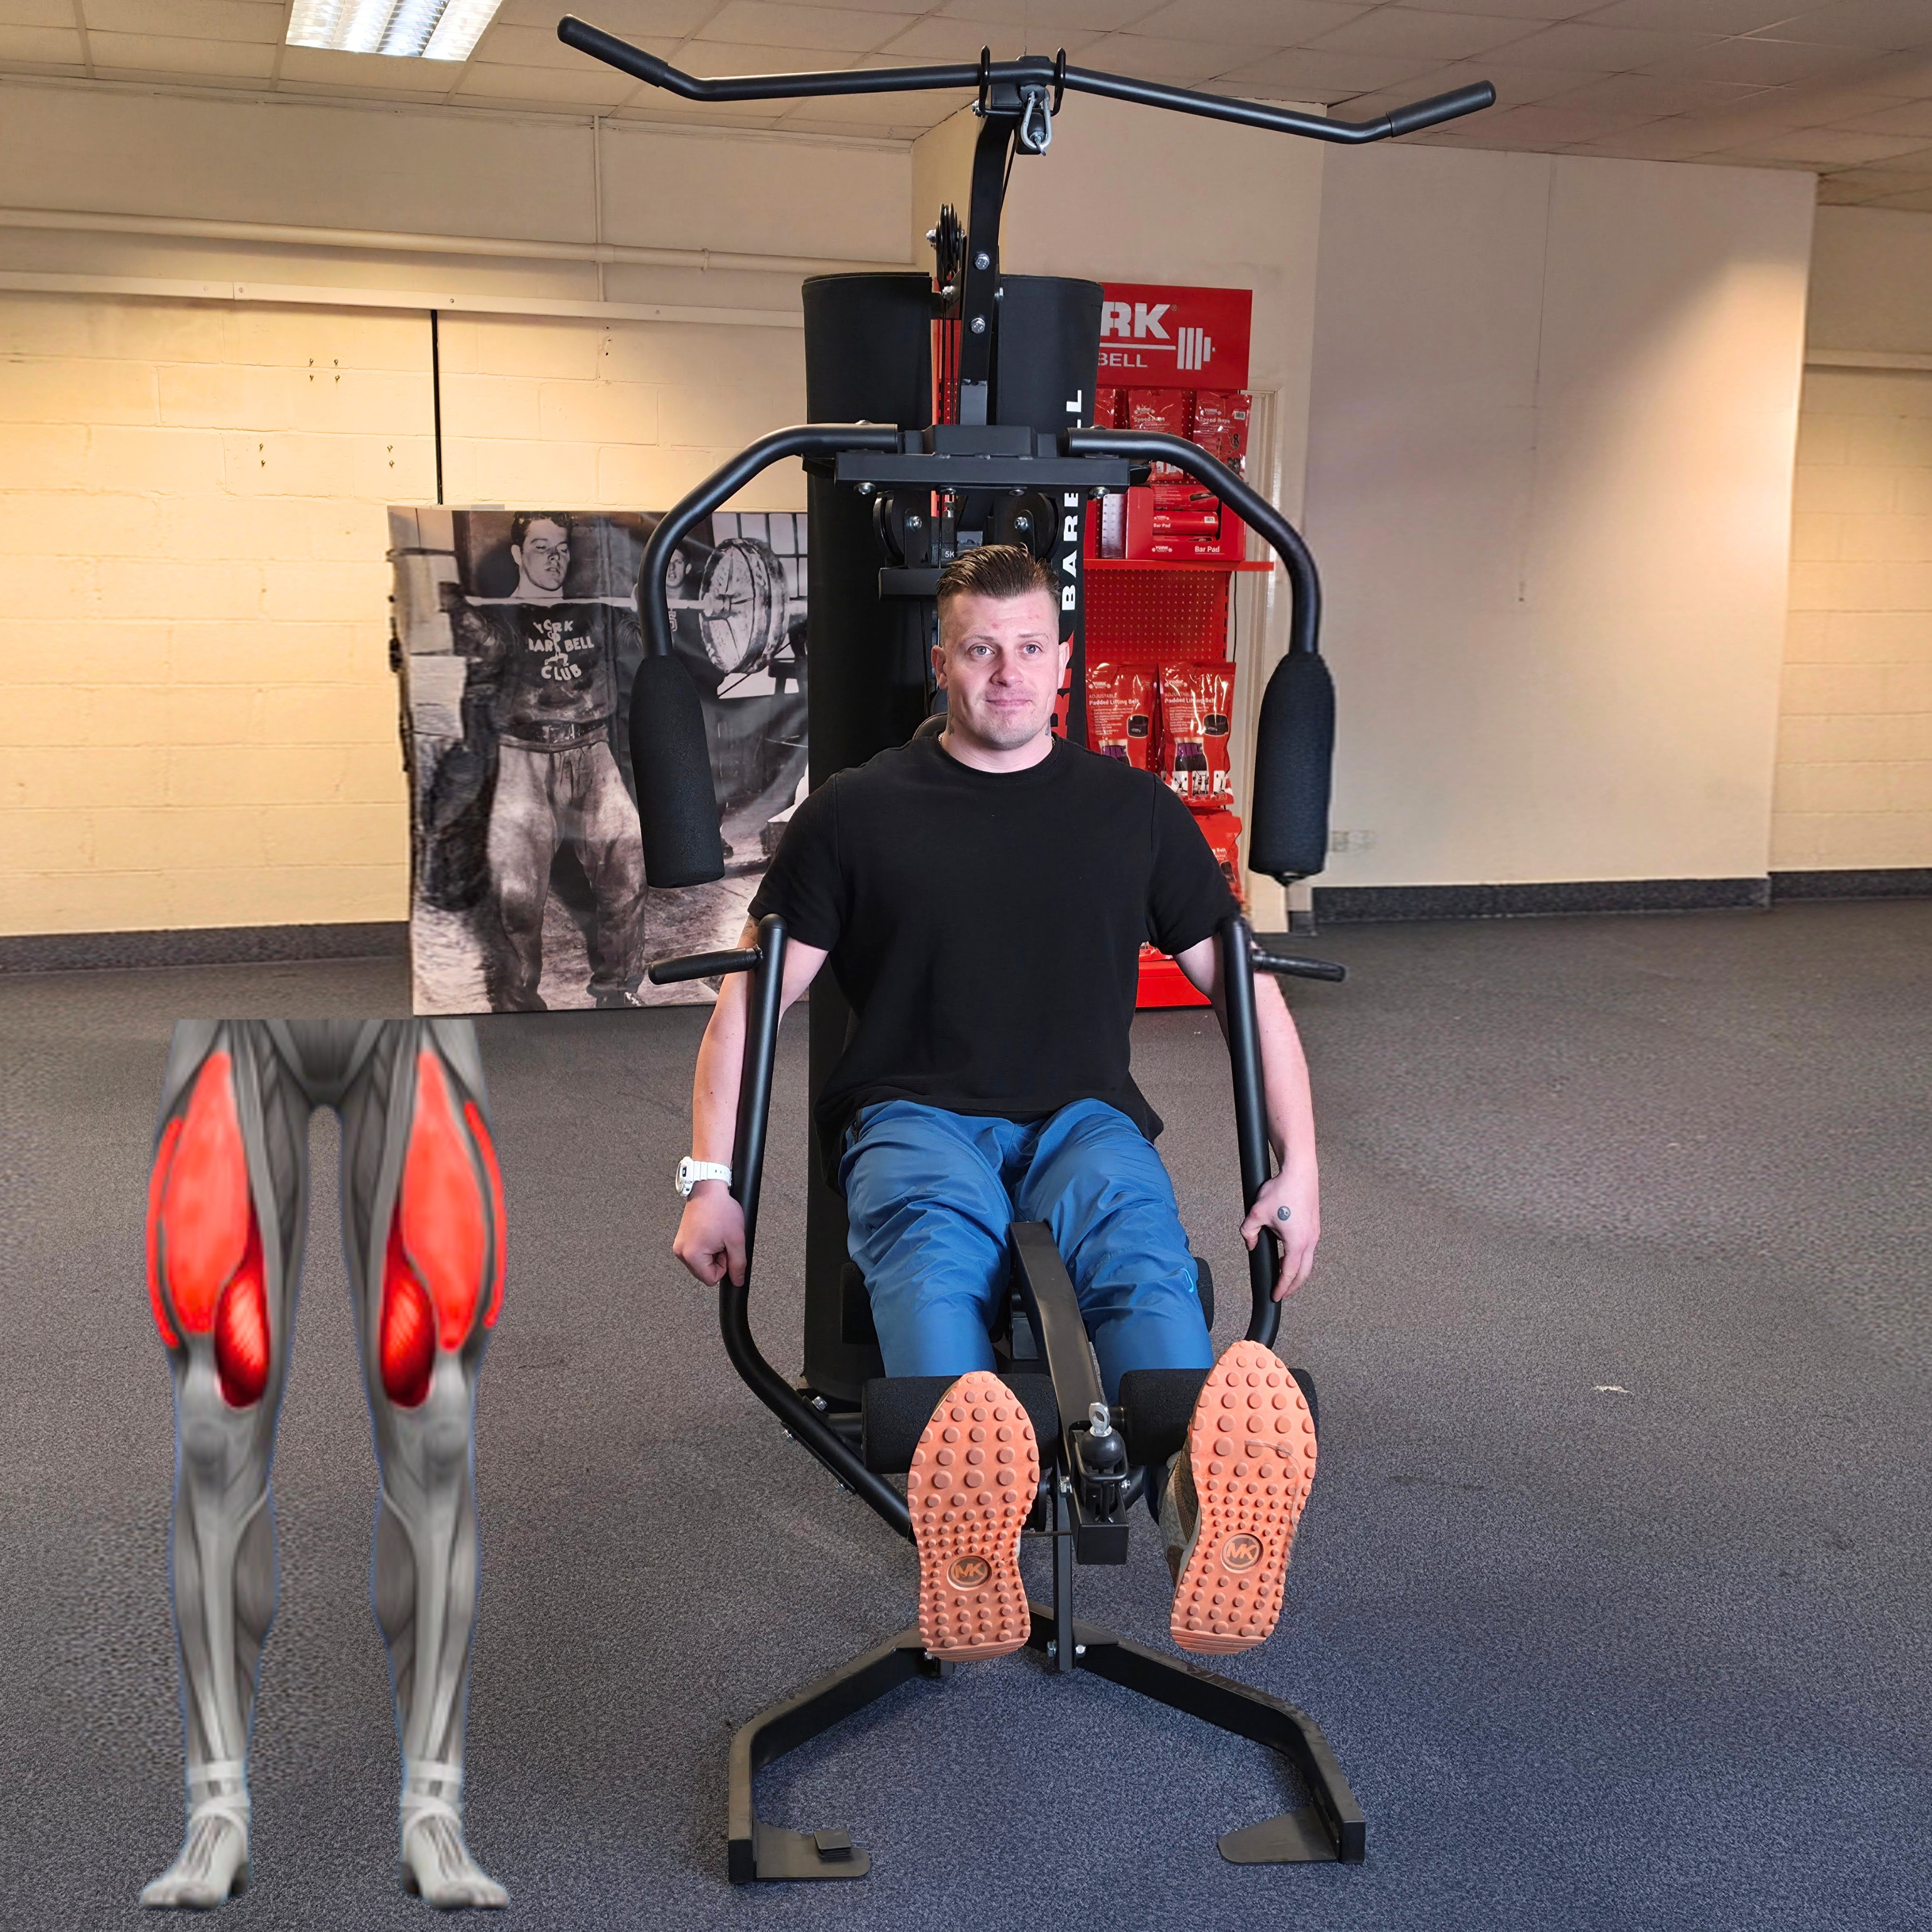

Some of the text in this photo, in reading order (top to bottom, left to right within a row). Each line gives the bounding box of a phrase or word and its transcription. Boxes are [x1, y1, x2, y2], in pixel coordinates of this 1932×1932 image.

[1100, 301, 1171, 340] RK
[1098, 352, 1148, 368] BELL
[564, 636, 595, 652] BELL
[541, 664, 582, 681] CLUB
[1226, 1543, 1257, 1560] MK
[955, 1563, 984, 1579] MK
